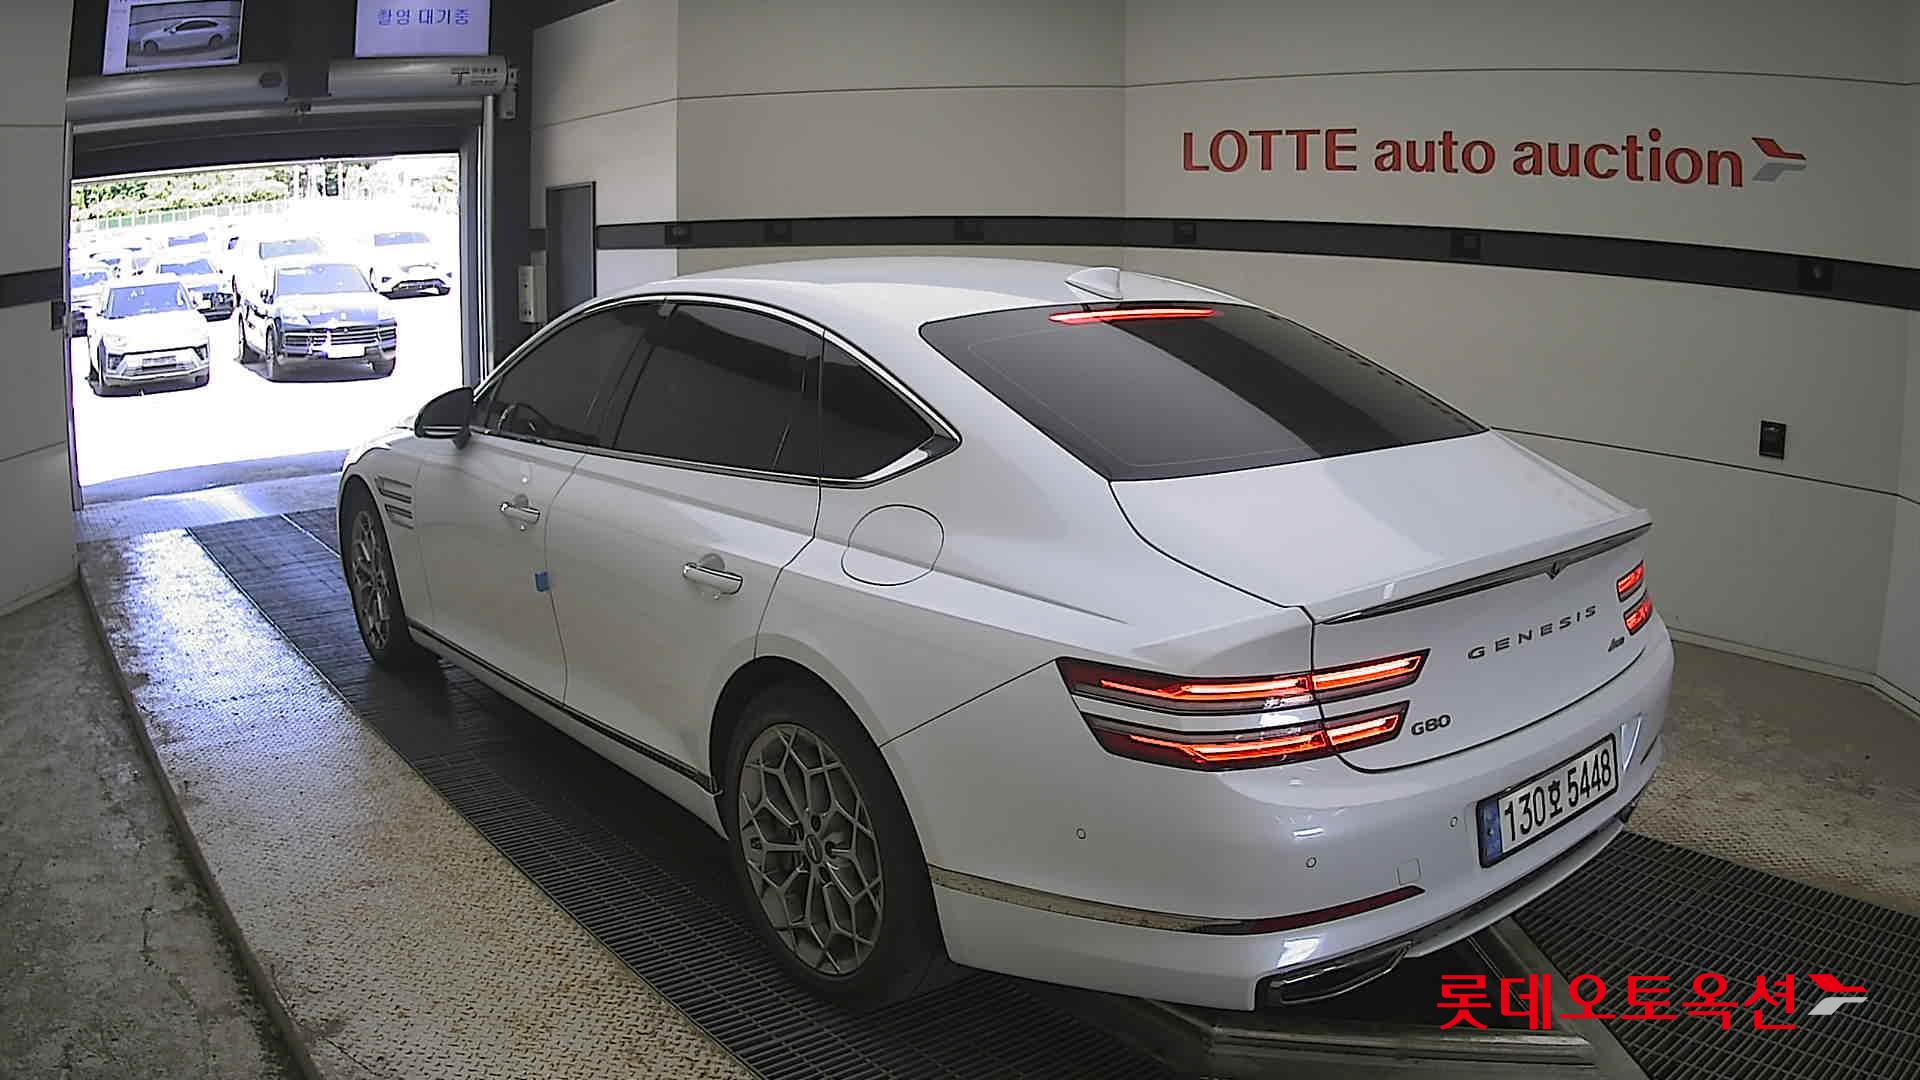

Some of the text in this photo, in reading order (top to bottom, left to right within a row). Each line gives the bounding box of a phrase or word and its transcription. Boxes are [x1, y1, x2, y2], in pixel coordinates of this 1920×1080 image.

[419, 8, 469, 26] 대기중
[1184, 128, 1744, 186] LOTTE auto auction
[1467, 605, 1597, 660] GENESIS
[1411, 714, 1452, 736] G80
[1567, 749, 1612, 807] 5448
